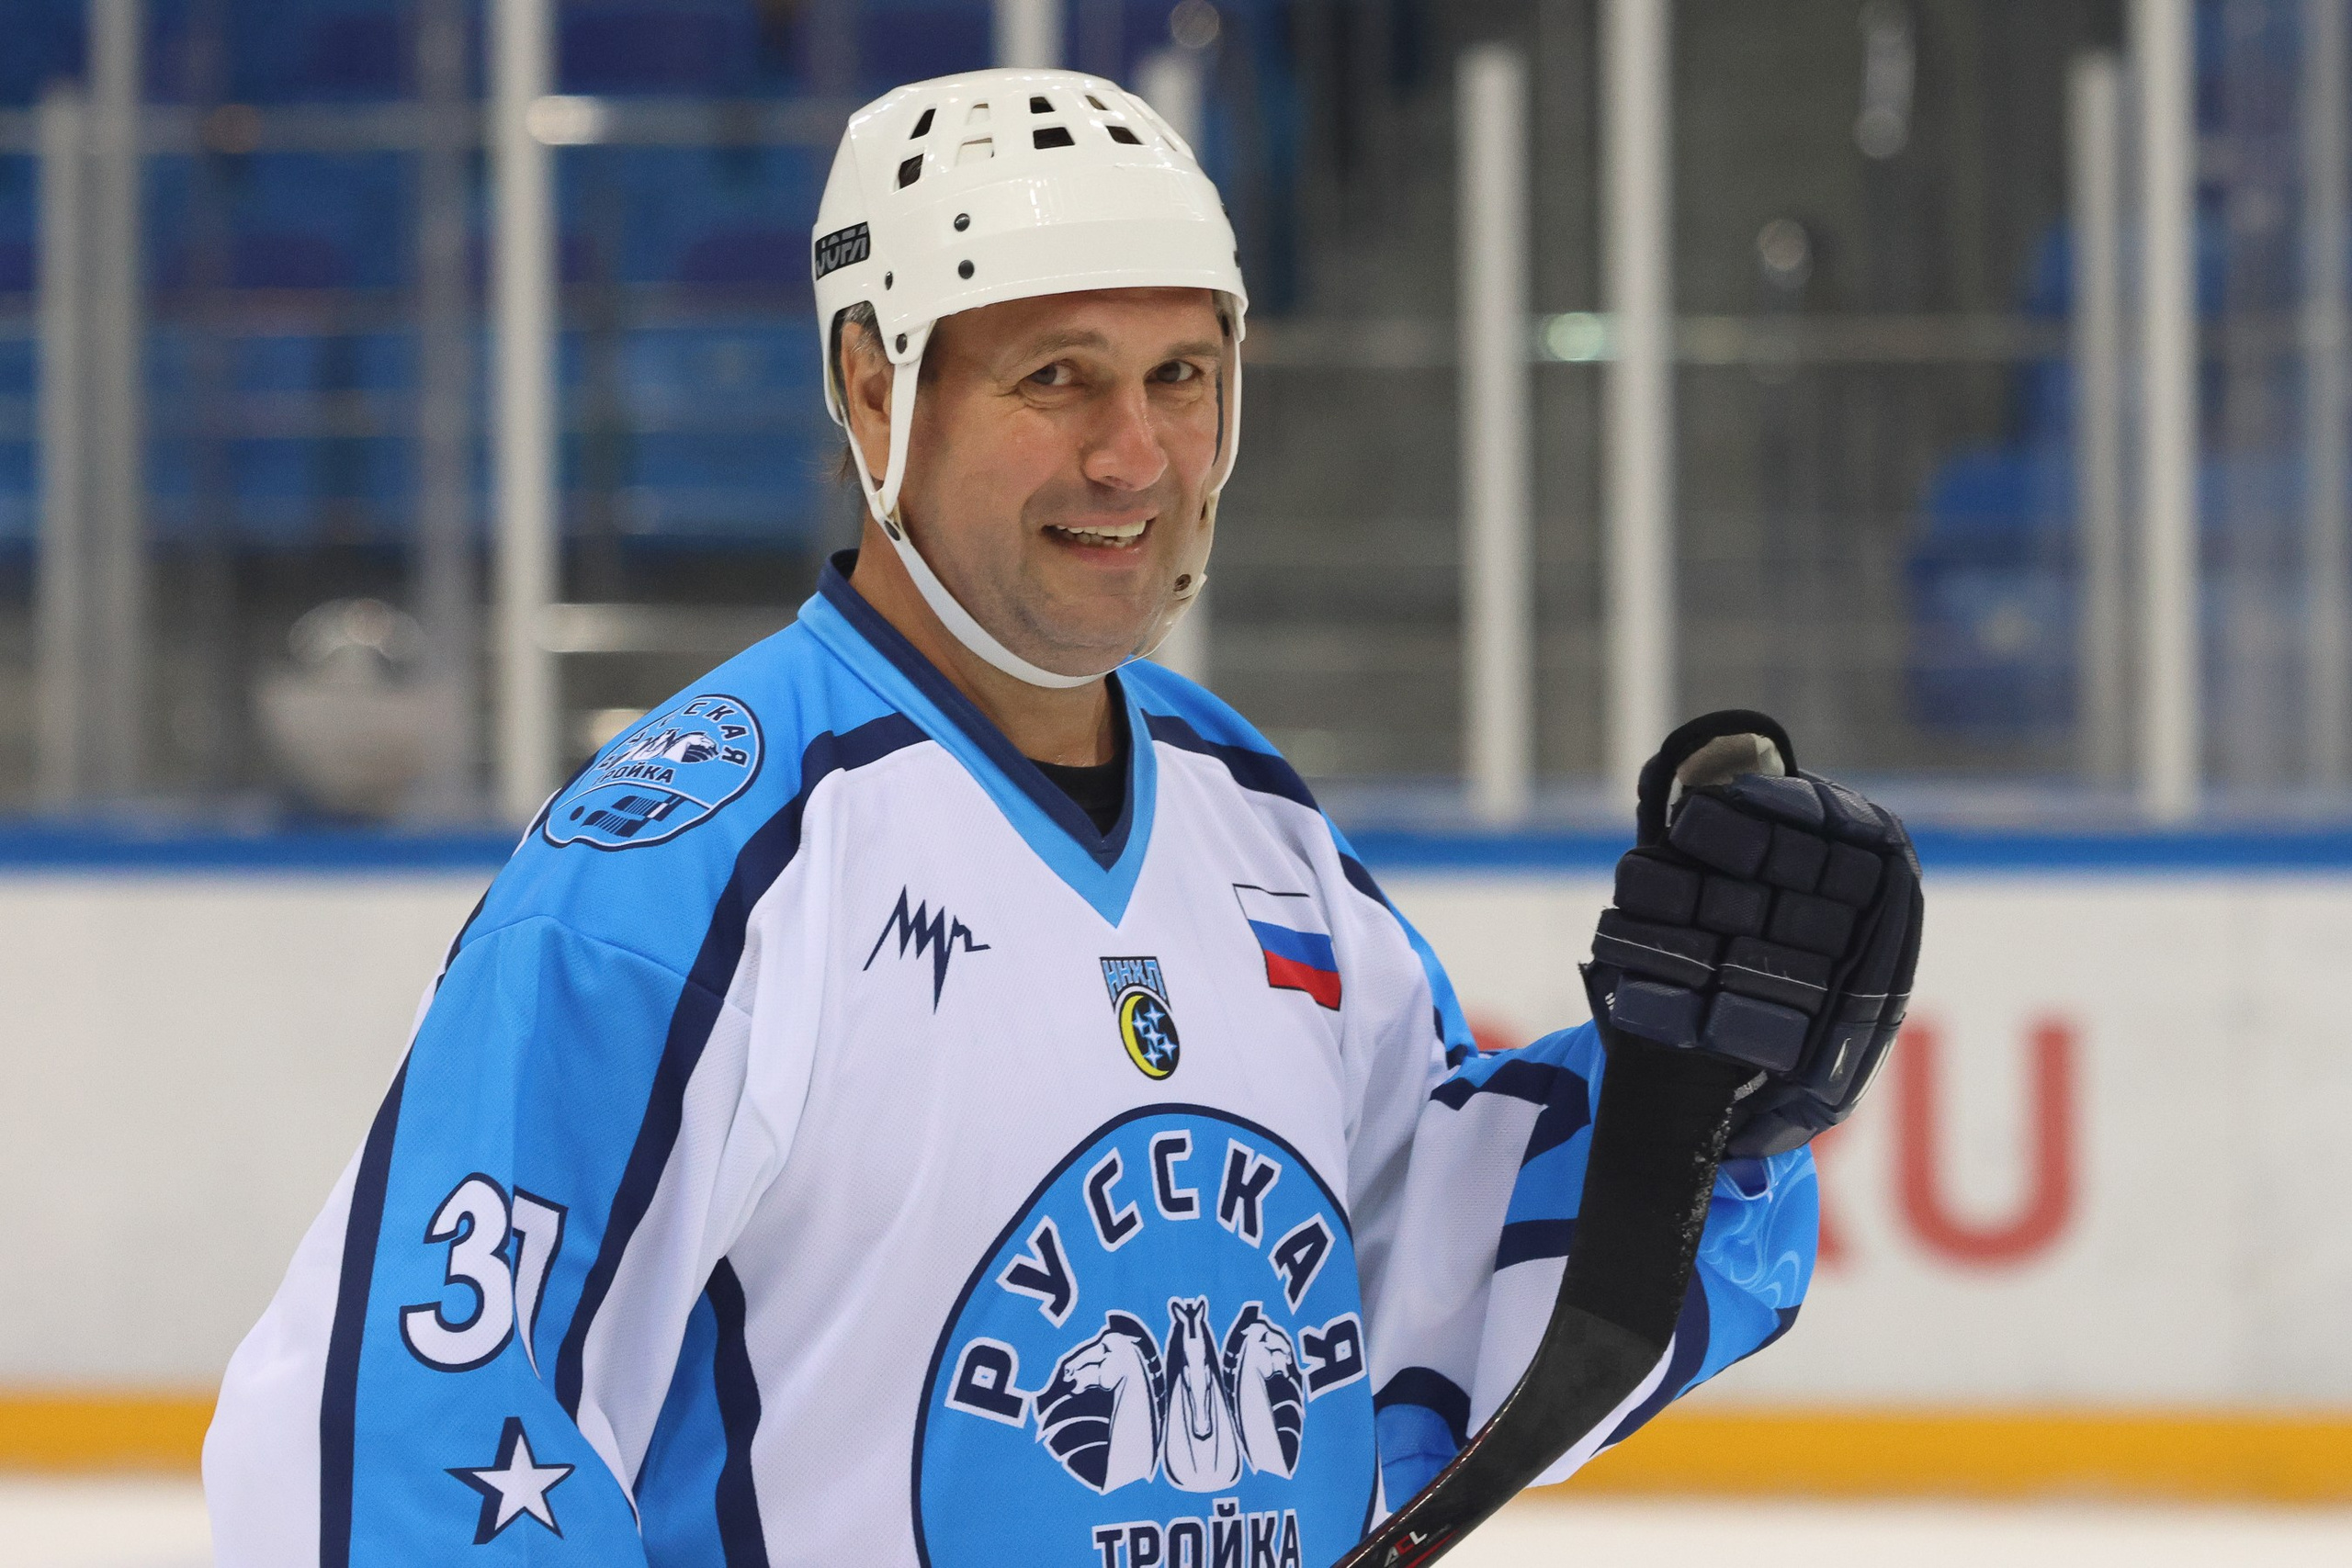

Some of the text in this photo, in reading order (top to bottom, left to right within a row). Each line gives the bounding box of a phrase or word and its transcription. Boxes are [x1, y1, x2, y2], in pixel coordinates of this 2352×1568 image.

[816, 225, 868, 276] JOFA
[944, 1129, 1369, 1429] РУССКАЯ
[1092, 1496, 1301, 1568] ТРОЙКА
